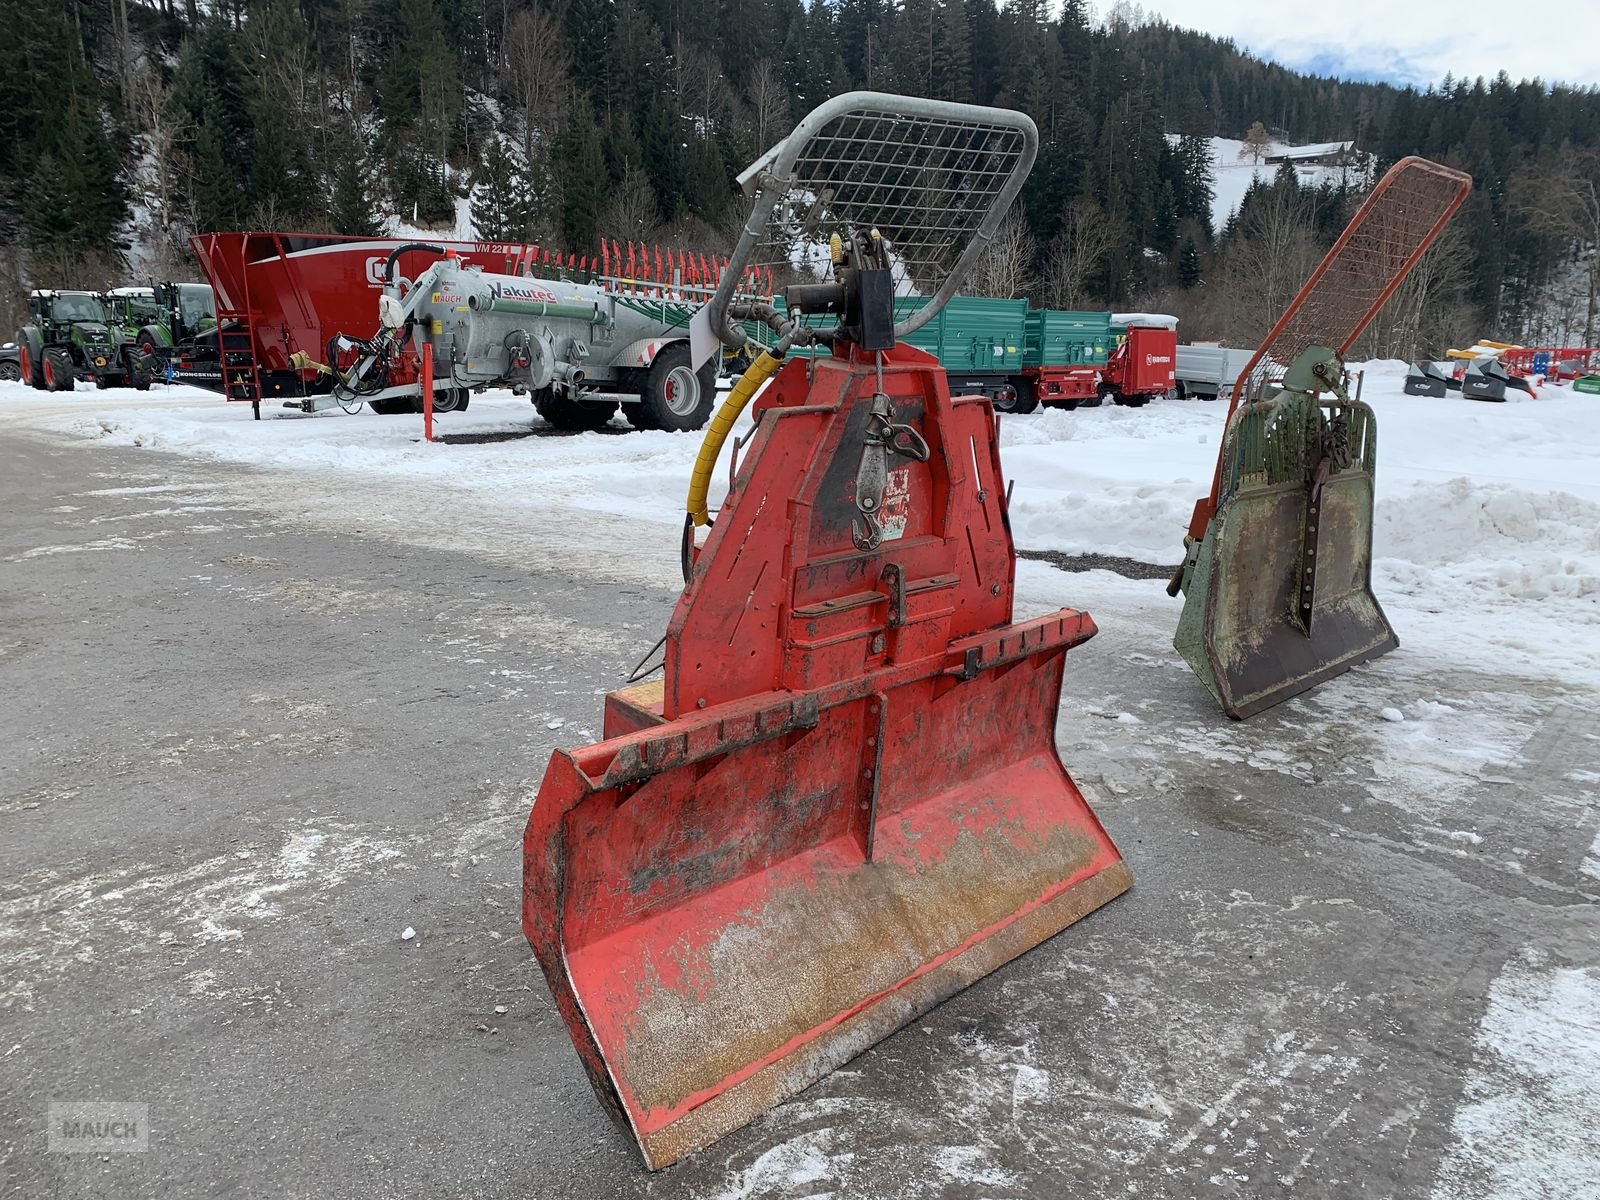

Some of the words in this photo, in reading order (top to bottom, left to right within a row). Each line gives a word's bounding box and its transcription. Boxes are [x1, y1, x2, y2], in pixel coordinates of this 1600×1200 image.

[475, 245, 489, 253] VM
[491, 245, 503, 253] 22
[488, 282, 556, 301] Nakutec
[434, 295, 462, 303] MAUCH
